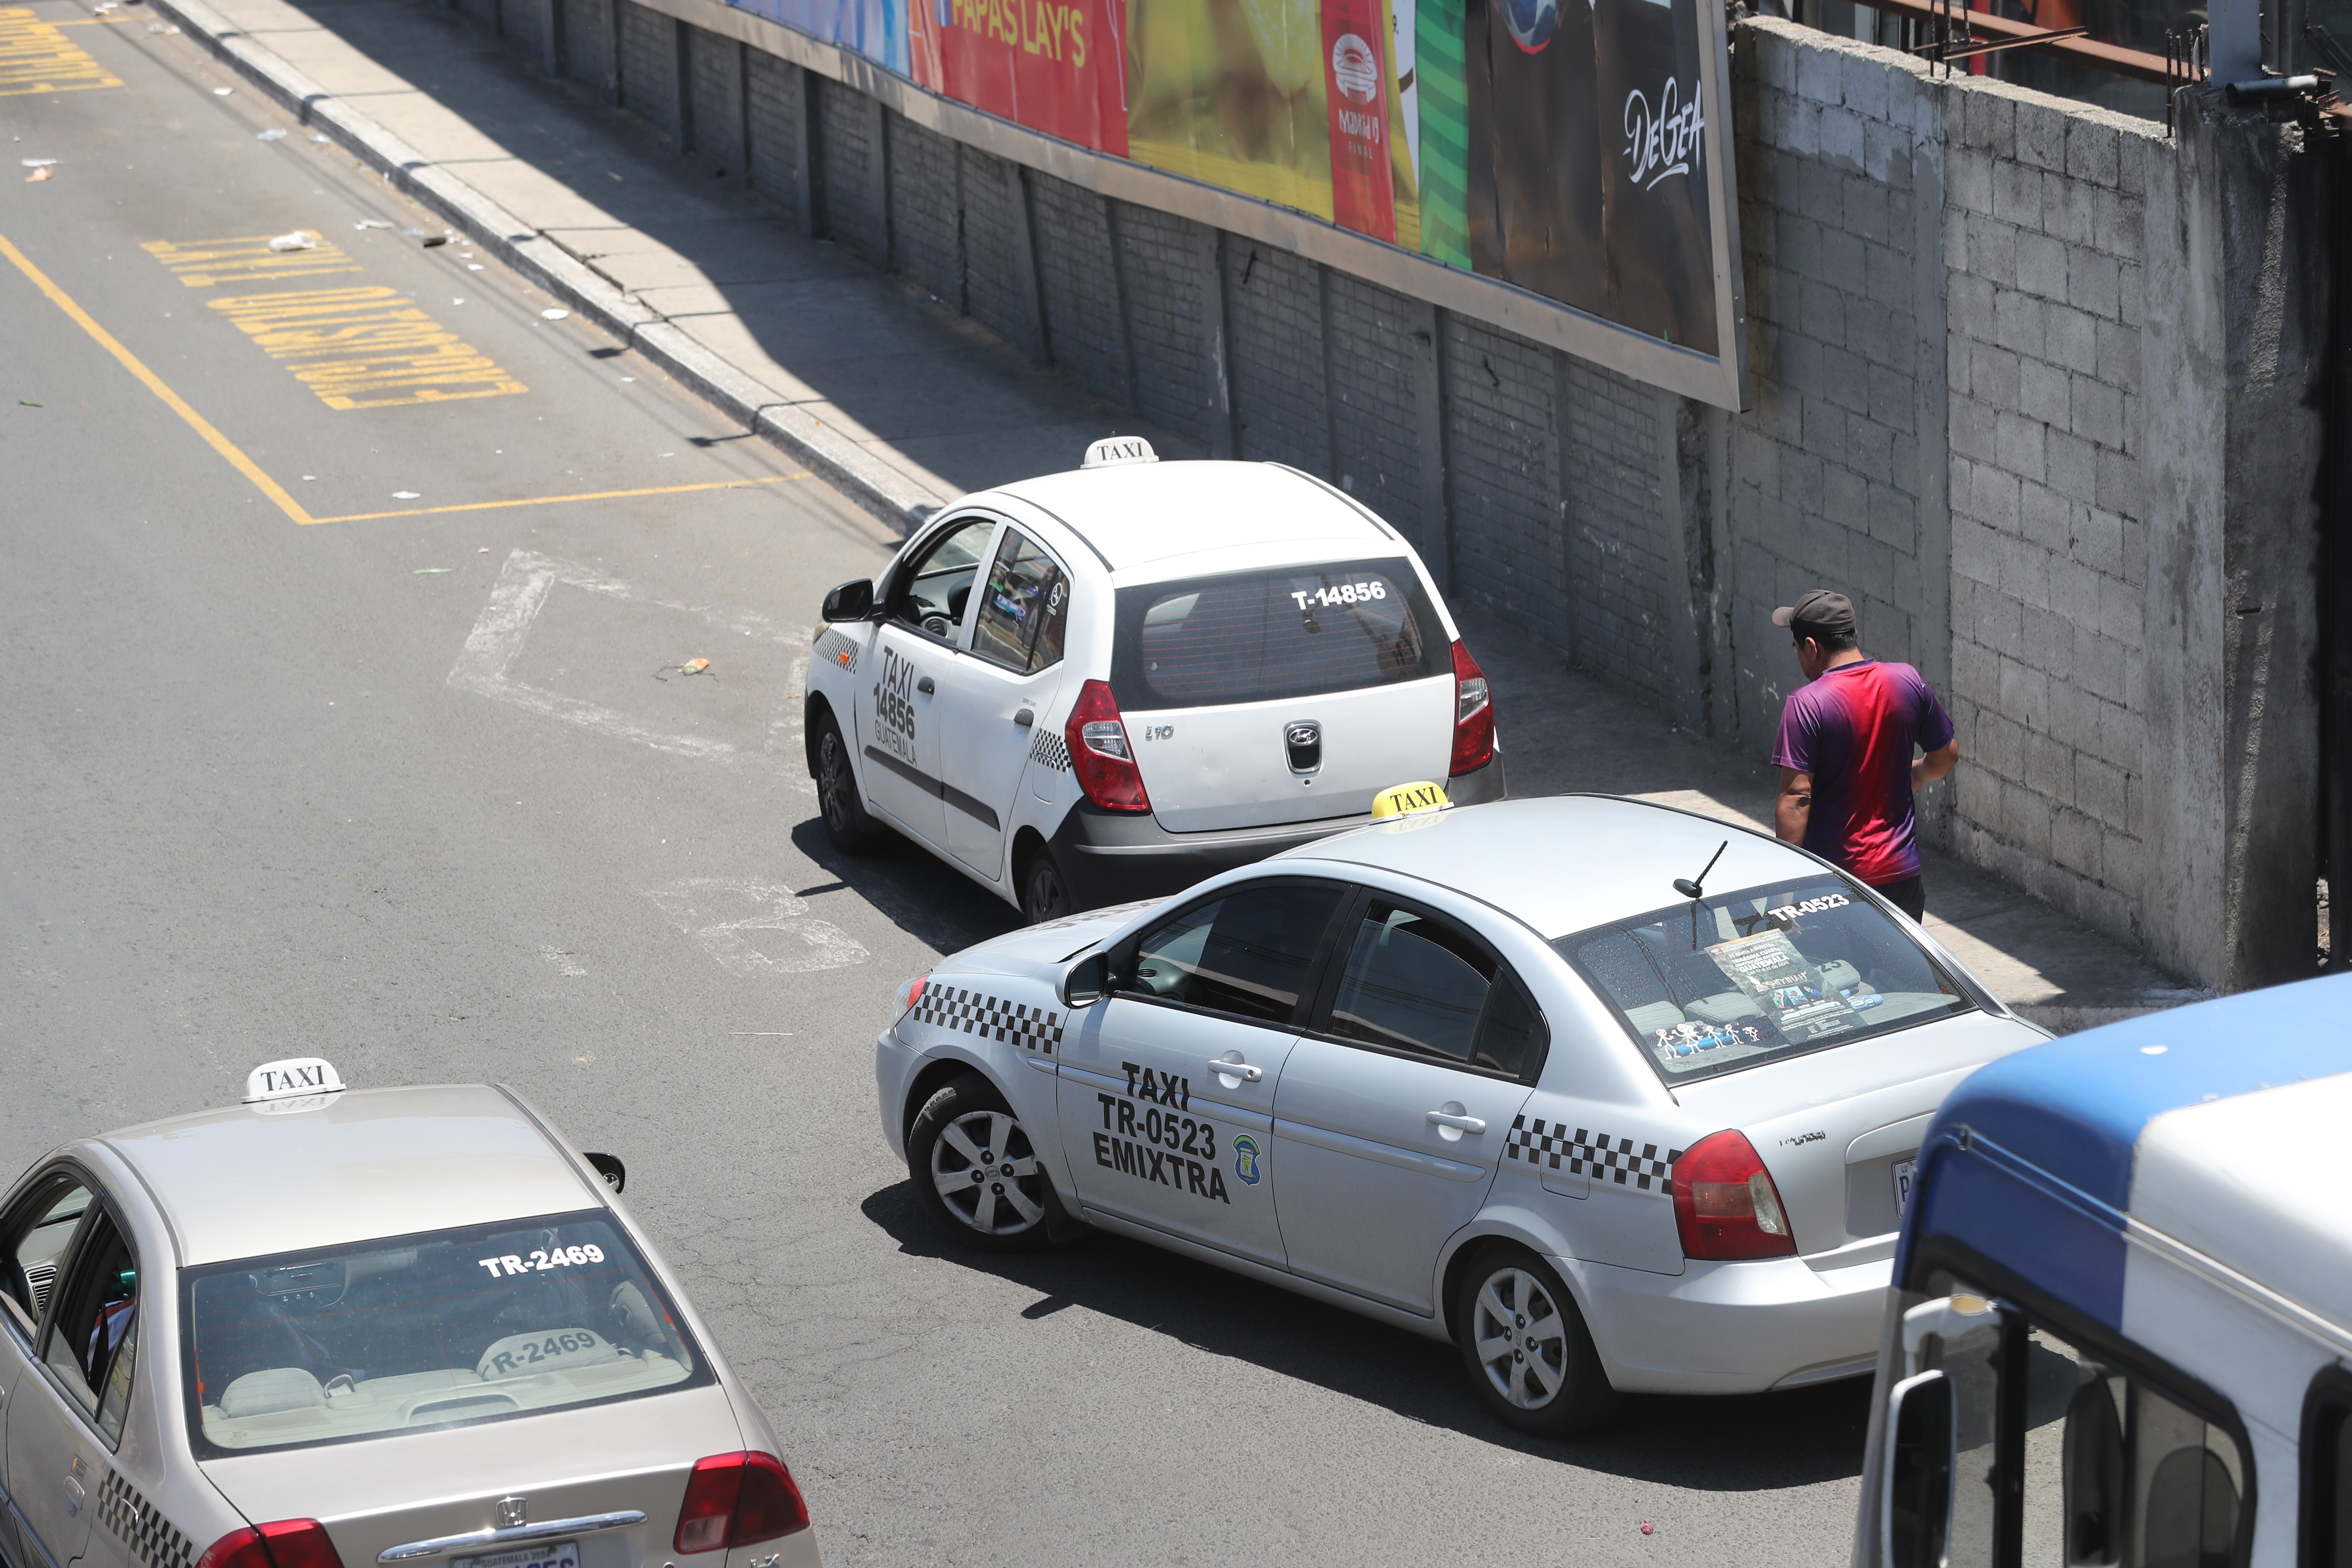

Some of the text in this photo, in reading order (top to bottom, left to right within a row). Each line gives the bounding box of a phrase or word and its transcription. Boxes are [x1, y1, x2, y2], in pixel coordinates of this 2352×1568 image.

[1348, 141, 1373, 160] FINAL
[1097, 442, 1144, 460] TAXI
[1291, 581, 1386, 610] T-14856
[883, 645, 914, 702] TAXI
[874, 682, 915, 740] 14856
[875, 719, 917, 767] GUATEMALA
[1390, 786, 1438, 812] TAXI
[1767, 894, 1850, 921] TR-0523
[1752, 942, 1776, 951] NUESTRA
[1758, 946, 1782, 956] CUARTA
[1761, 950, 1785, 959] NACIONAL
[1739, 954, 1790, 973] GUATEMALA
[260, 1065, 325, 1092] TAXI
[1122, 1061, 1189, 1112] TAXI
[1098, 1093, 1216, 1161] TR-0523
[1093, 1131, 1231, 1205] EMIXTRA
[478, 1243, 605, 1277] TR-2469
[481, 1553, 529, 1568] GUATEMALA
